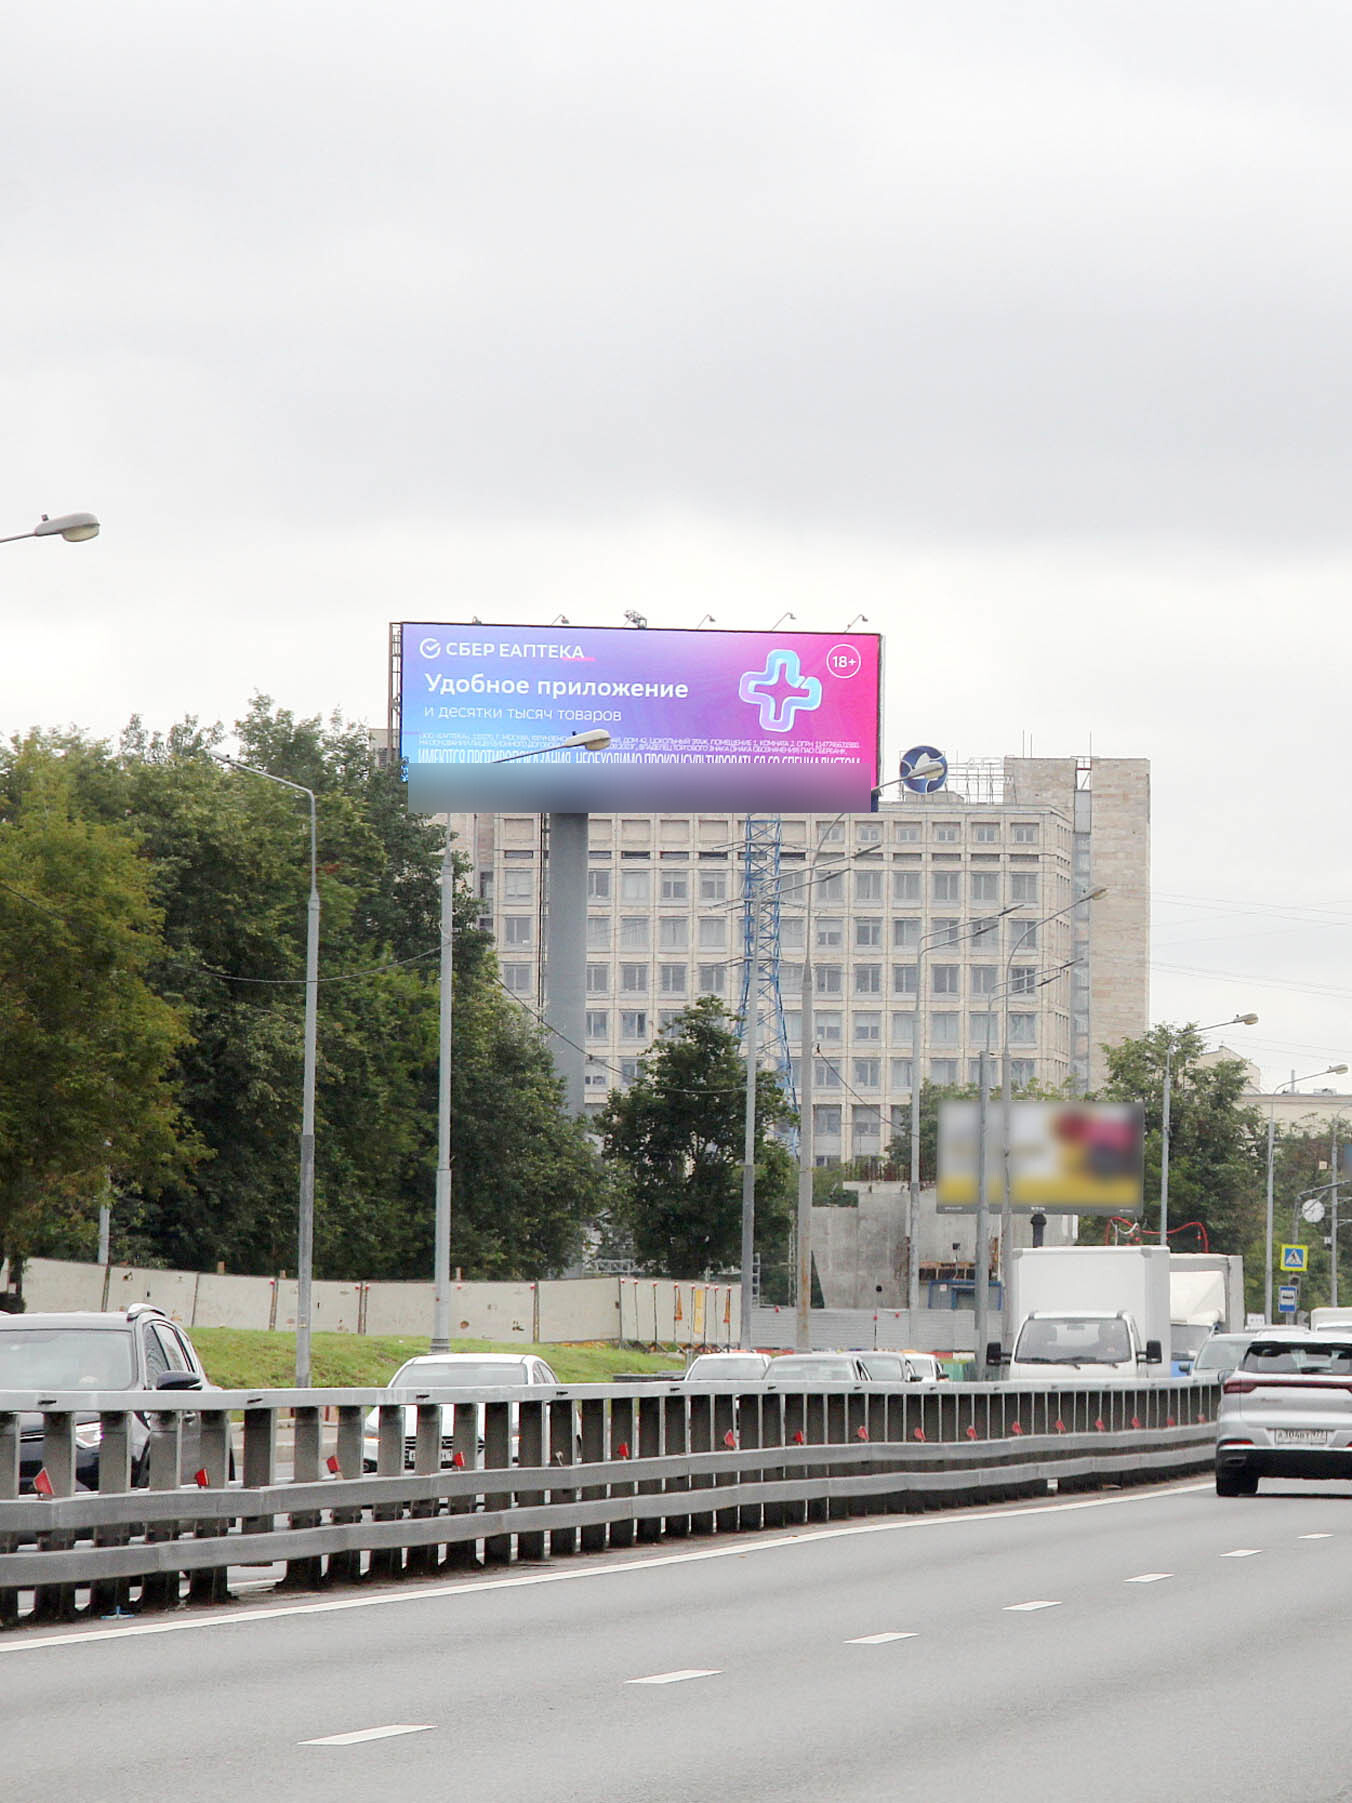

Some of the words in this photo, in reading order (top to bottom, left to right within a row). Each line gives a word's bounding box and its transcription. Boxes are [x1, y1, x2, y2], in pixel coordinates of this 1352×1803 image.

[446, 642, 496, 657] СБЕР
[499, 643, 585, 659] ЕАПТЕКА
[832, 655, 857, 668] 18+
[424, 673, 530, 695] Удобное
[537, 679, 689, 699] приложение
[424, 706, 434, 718] и
[438, 706, 502, 720] десятки
[508, 708, 553, 721] тысяч
[558, 709, 622, 723] товаров
